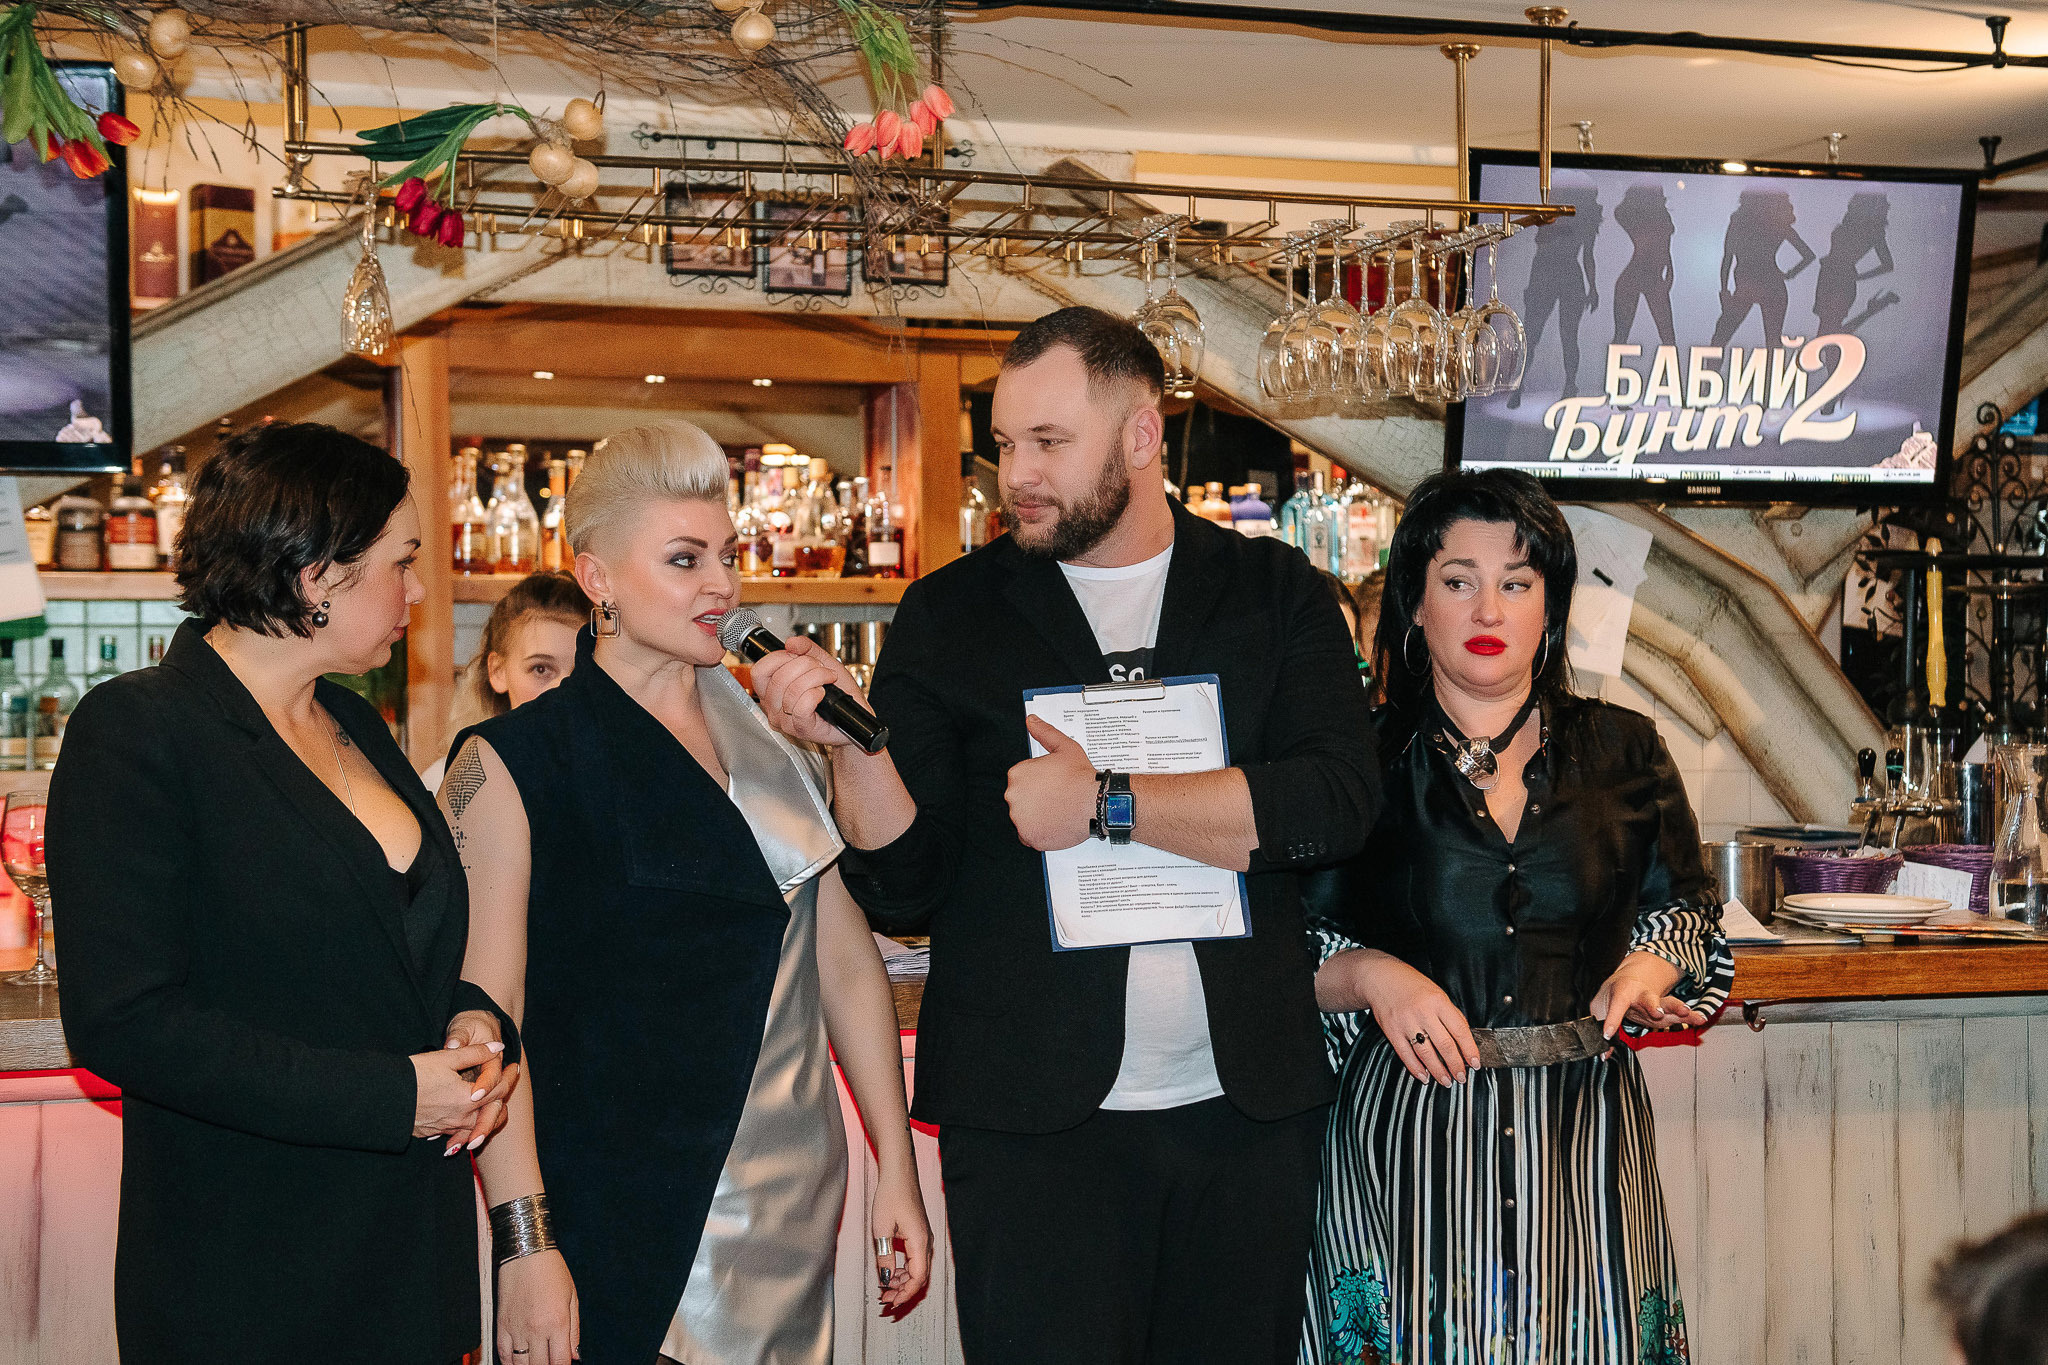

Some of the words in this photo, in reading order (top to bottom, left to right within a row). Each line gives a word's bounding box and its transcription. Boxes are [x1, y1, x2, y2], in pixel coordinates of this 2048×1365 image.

[1605, 335, 1808, 410] БАБИЙ
[1780, 333, 1867, 446] 2
[1543, 395, 1764, 465] Бунт
[1687, 486, 1720, 495] SAMSUNG
